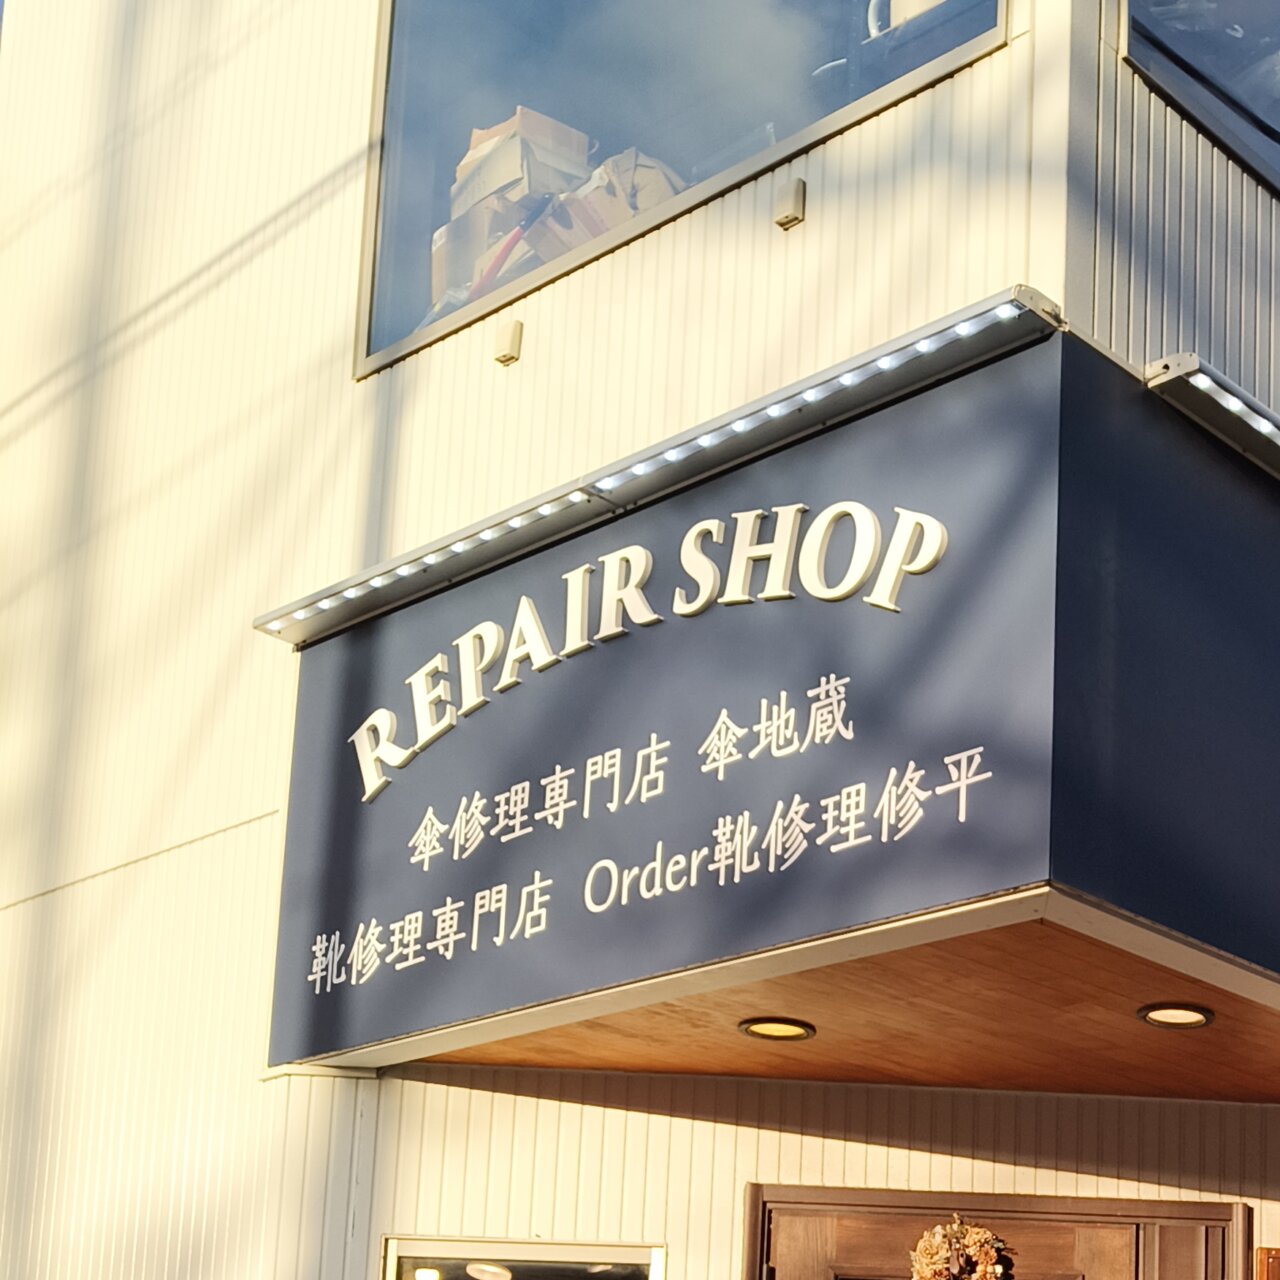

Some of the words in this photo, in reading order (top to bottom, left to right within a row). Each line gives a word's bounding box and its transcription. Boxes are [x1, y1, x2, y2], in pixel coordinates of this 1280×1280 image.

[347, 544, 663, 802] REPAIR
[672, 500, 949, 613] SHOP
[408, 733, 671, 872] 傘修理専門店
[698, 674, 855, 781] 傘地蔵
[307, 871, 554, 995] 靴修理専門店
[584, 746, 993, 915] Order靴修理修平
